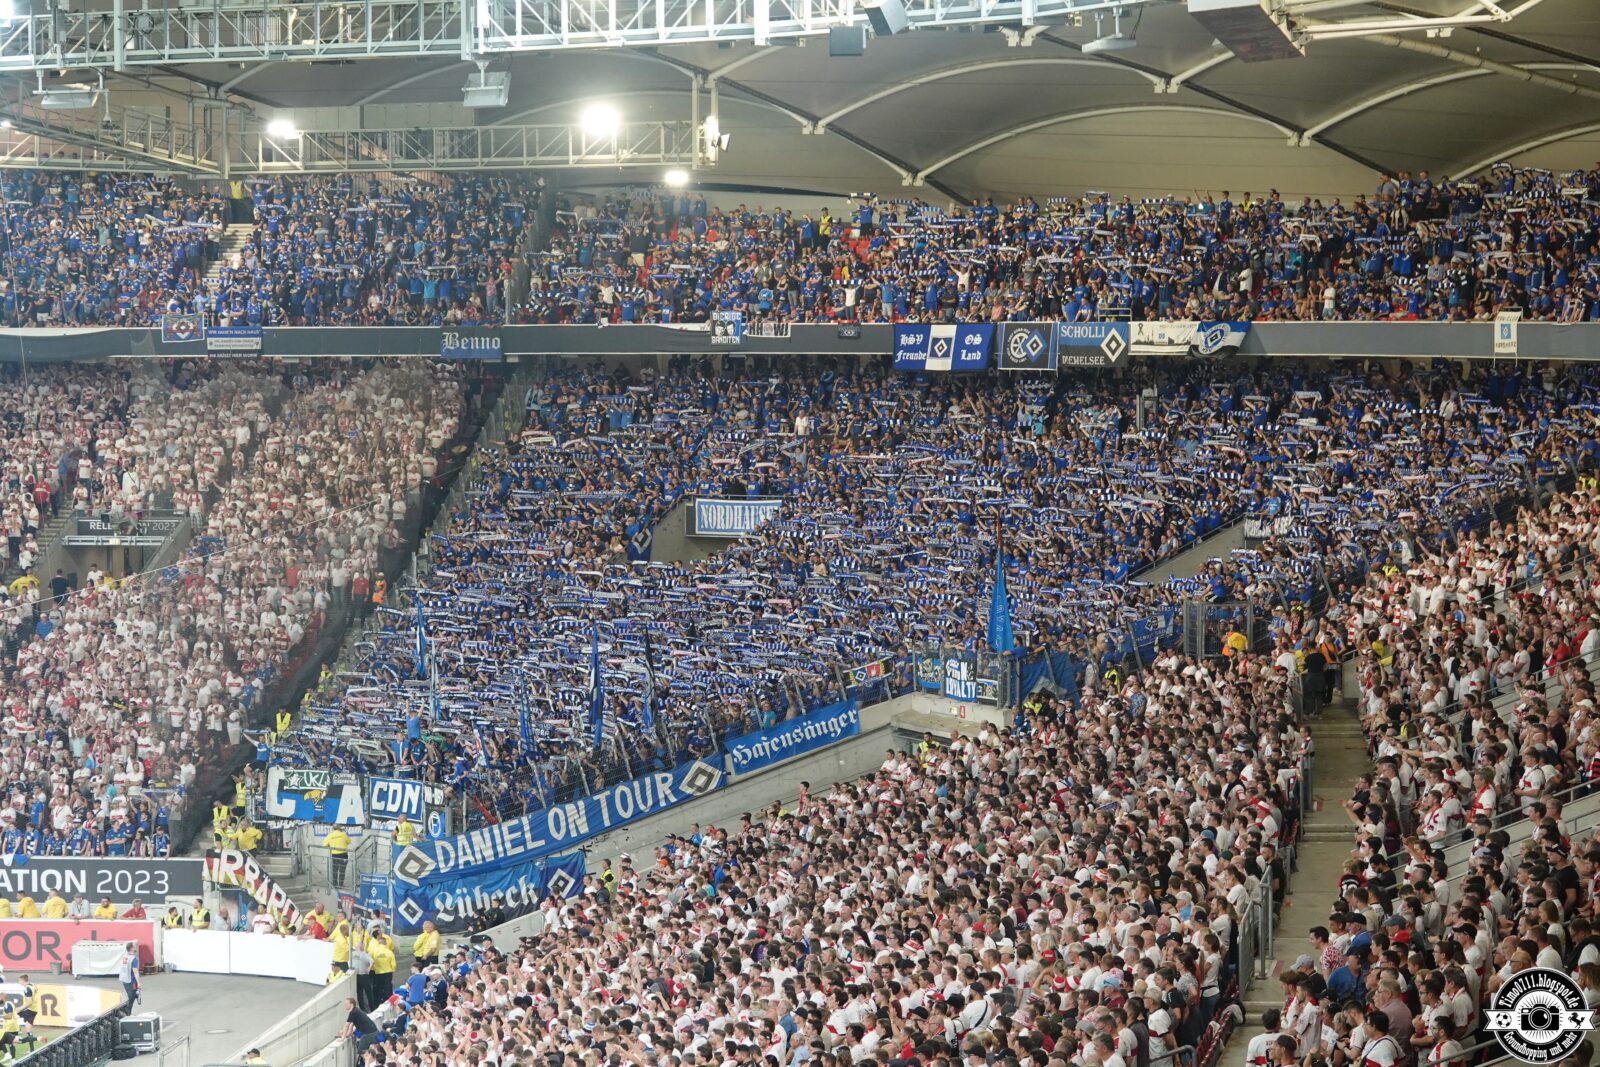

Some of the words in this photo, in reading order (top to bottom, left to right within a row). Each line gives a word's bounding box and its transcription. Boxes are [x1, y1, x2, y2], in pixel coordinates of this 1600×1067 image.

[441, 331, 501, 352] Benno
[899, 333, 924, 346] HSV
[1061, 325, 1105, 338] SCHOLLI
[895, 349, 927, 362] Freunde
[960, 348, 982, 361] Land
[731, 708, 859, 767] Hafensänger
[371, 780, 421, 815] CDN
[435, 812, 545, 874] DANIEL
[547, 800, 589, 842] ON
[593, 772, 679, 828] TOUR
[97, 869, 169, 895] 2023
[433, 872, 540, 922] Lübeck
